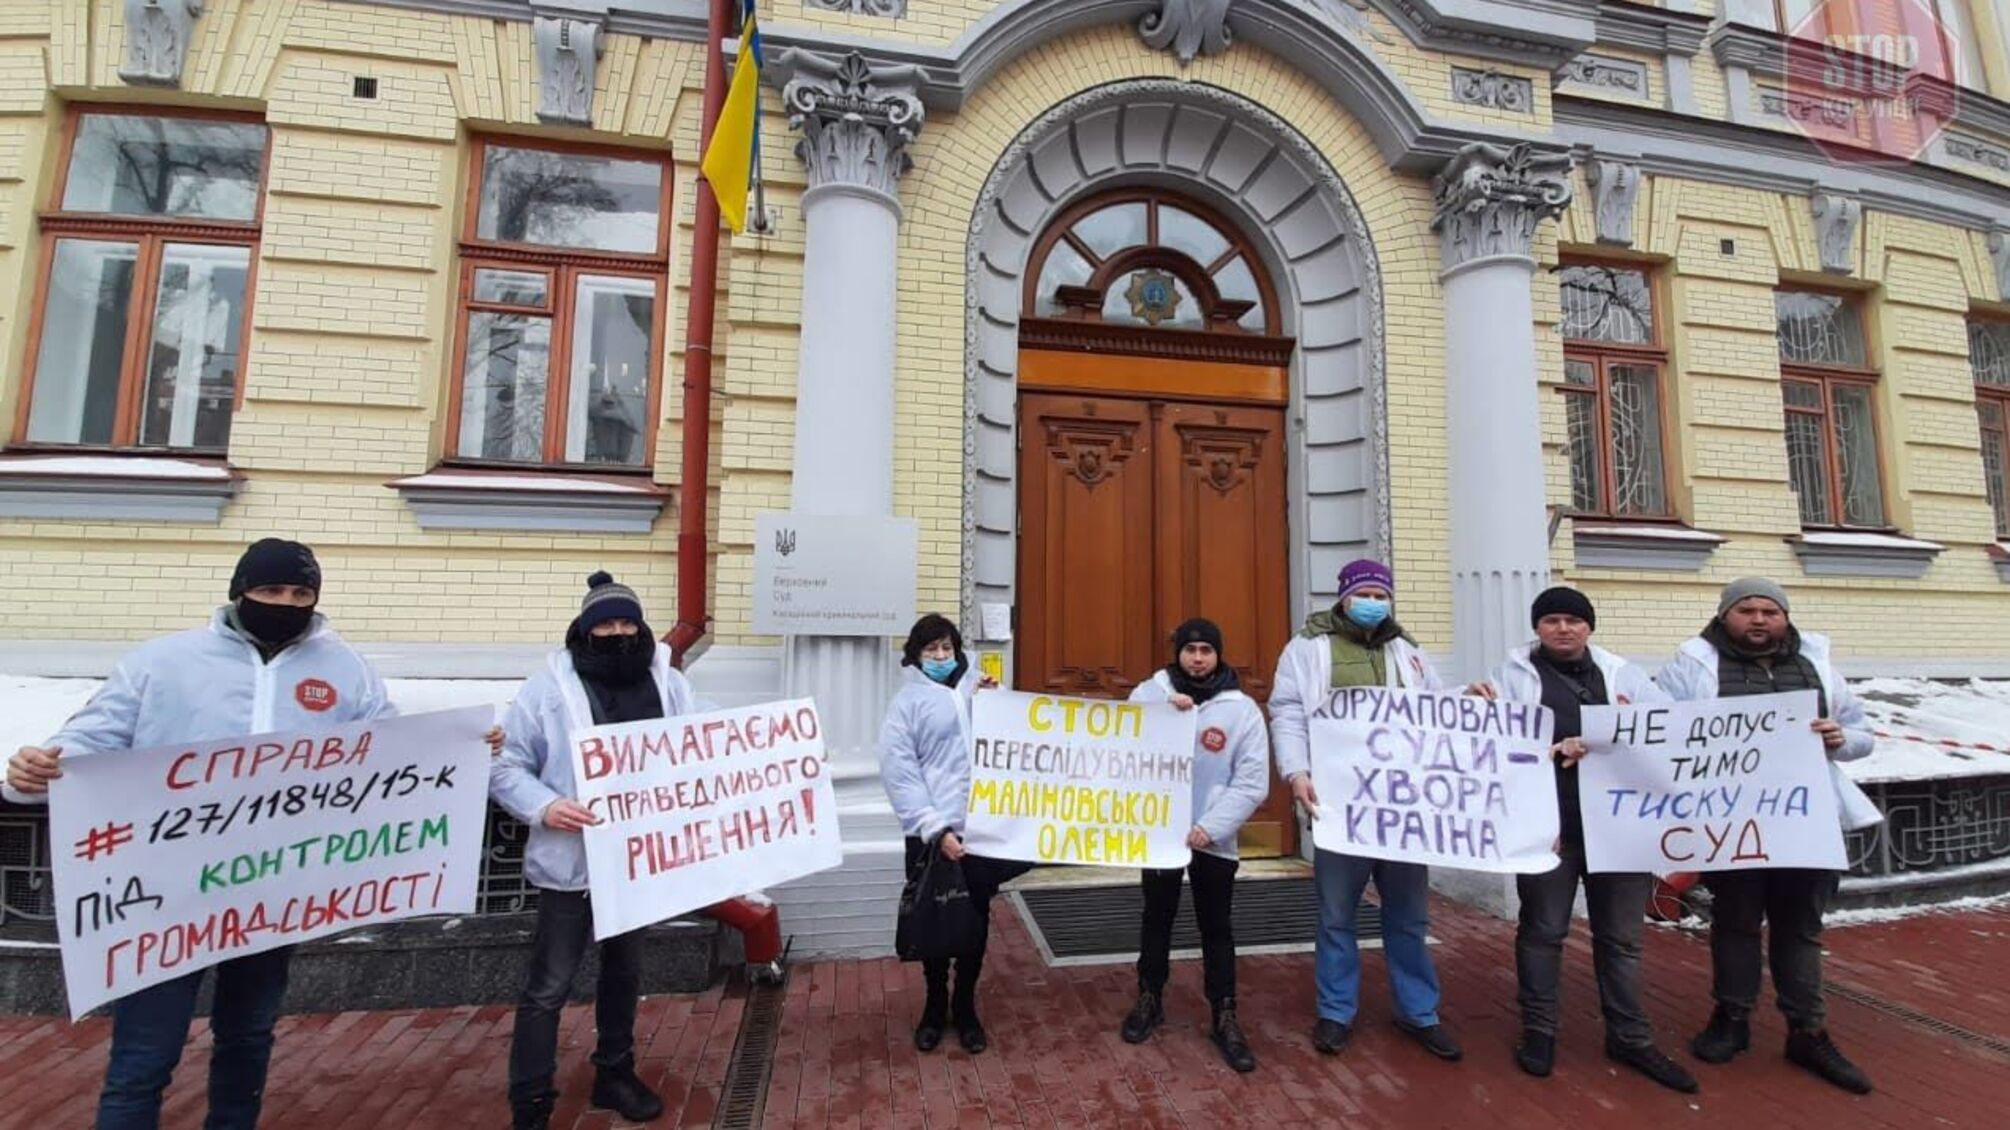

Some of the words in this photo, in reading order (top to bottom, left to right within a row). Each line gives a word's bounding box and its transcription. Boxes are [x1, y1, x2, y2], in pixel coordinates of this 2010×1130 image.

[1027, 696, 1143, 738] СТОП
[1611, 709, 1670, 745] НЕ
[166, 730, 373, 791] СПРАВА
[579, 707, 818, 782] ВИМАГАЄМО
[1670, 748, 1761, 782] ТИМО
[587, 755, 820, 826] СПРАВЕДЛИВОГО
[1352, 765, 1509, 817] ХВОРА
[1607, 784, 1742, 820] ТИСКУ
[1756, 786, 1809, 817] НА
[199, 813, 449, 895] КОНТРОЛЕМ
[626, 788, 817, 881] РІШЕННЯ!
[1037, 823, 1149, 863] ОЛЕНИ
[1345, 804, 1502, 860] КРАЇНА
[1660, 818, 1770, 863] СУД
